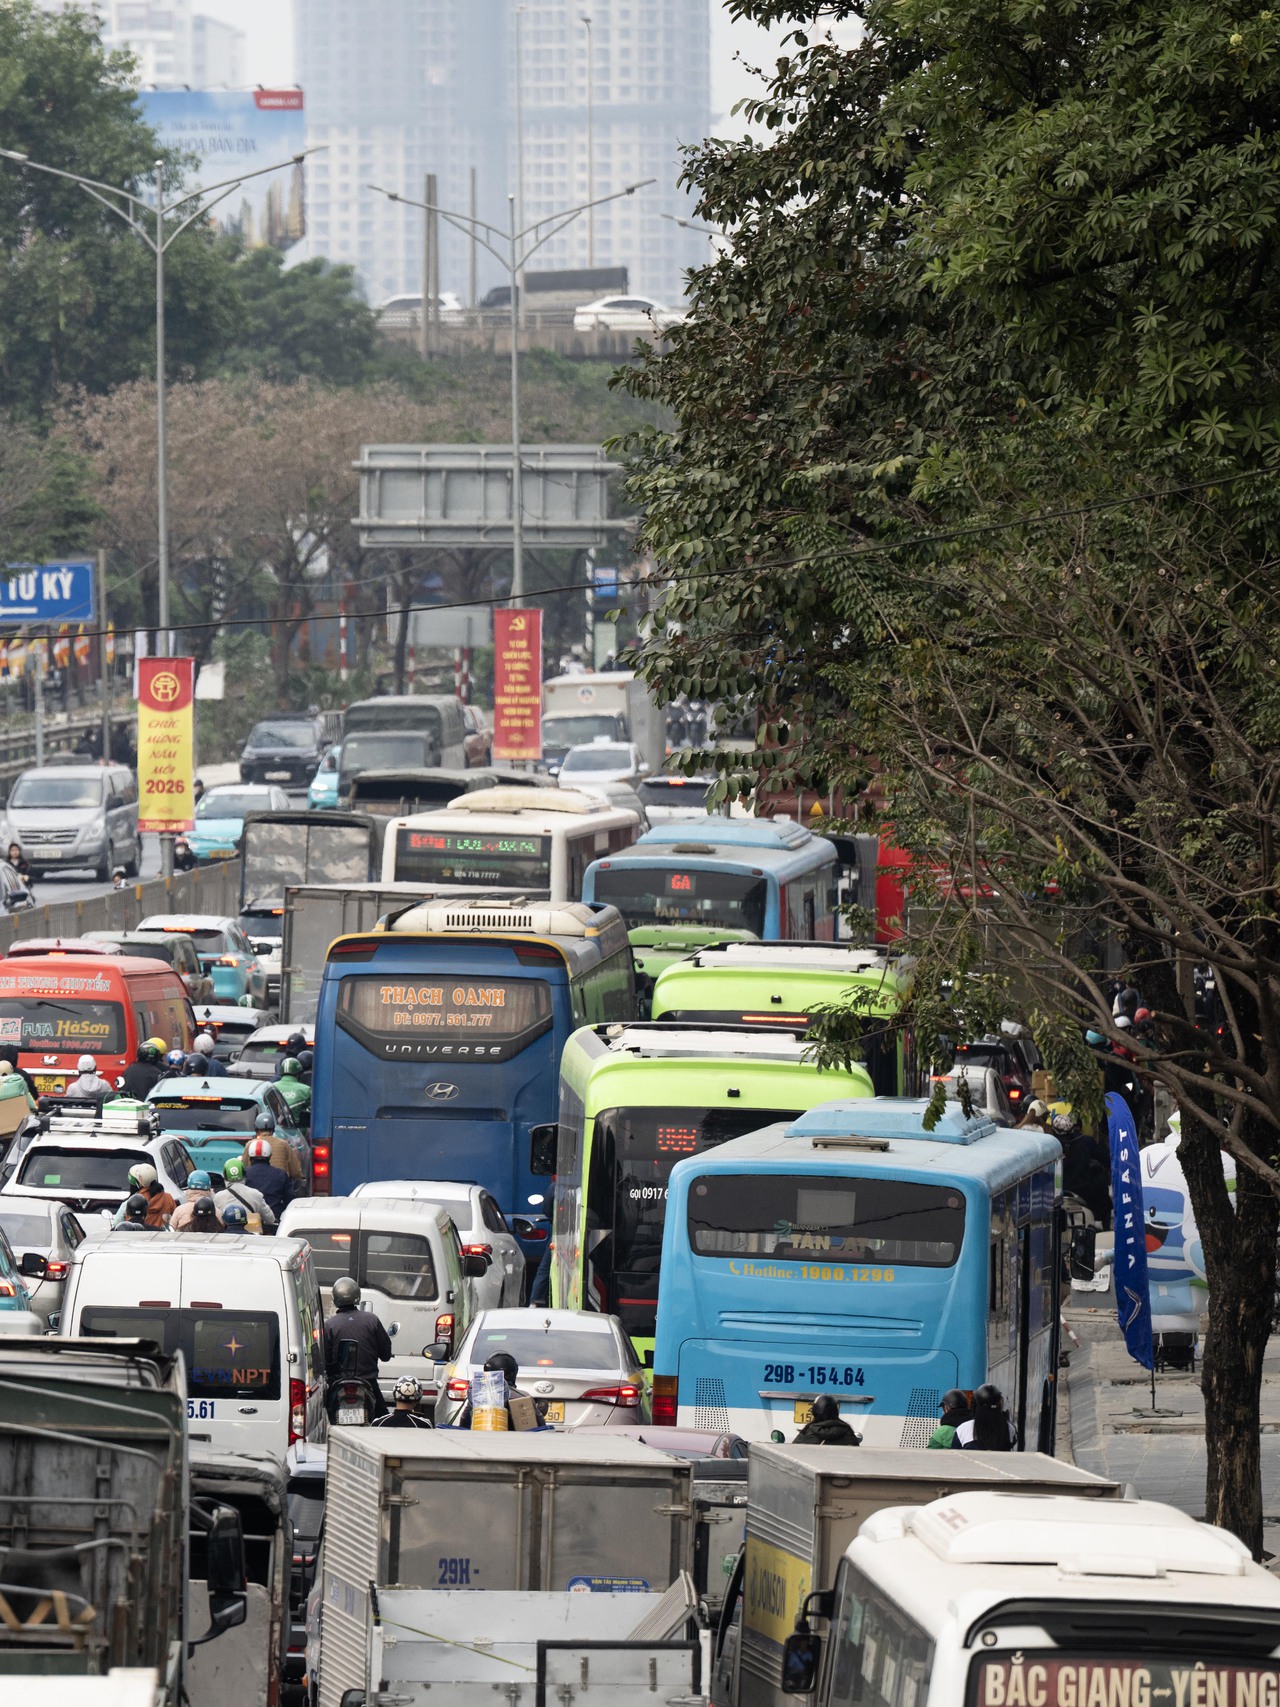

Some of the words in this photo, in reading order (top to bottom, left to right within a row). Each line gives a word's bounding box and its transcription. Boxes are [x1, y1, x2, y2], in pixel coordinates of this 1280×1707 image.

[42, 567, 74, 600] KỲ
[145, 779, 185, 794] 2026
[17, 976, 58, 990] TRUNG
[59, 972, 111, 992] CHUYỂN
[380, 986, 444, 1011] THẠCH
[452, 988, 506, 1007] OANH
[22, 1022, 54, 1037] FUTA
[393, 1012, 412, 1026] ĐT:
[412, 1013, 445, 1026] 0977.
[446, 1013, 493, 1027] 561.777
[385, 1044, 503, 1056] UNIVERSE
[629, 1188, 641, 1201] GỌI
[642, 1187, 663, 1200] 0917
[1118, 1128, 1136, 1270] VINFAST
[790, 1231, 830, 1250] TÂN
[743, 1263, 798, 1279] Hotline:
[799, 1266, 896, 1283] 1900.1296
[763, 1364, 795, 1384] 29B
[807, 1366, 866, 1387] 154.64
[984, 1650, 1047, 1707] BẮC
[1057, 1665, 1152, 1707] GIANG
[1170, 1660, 1230, 1707] YÊN
[1235, 1671, 1280, 1707] NG
